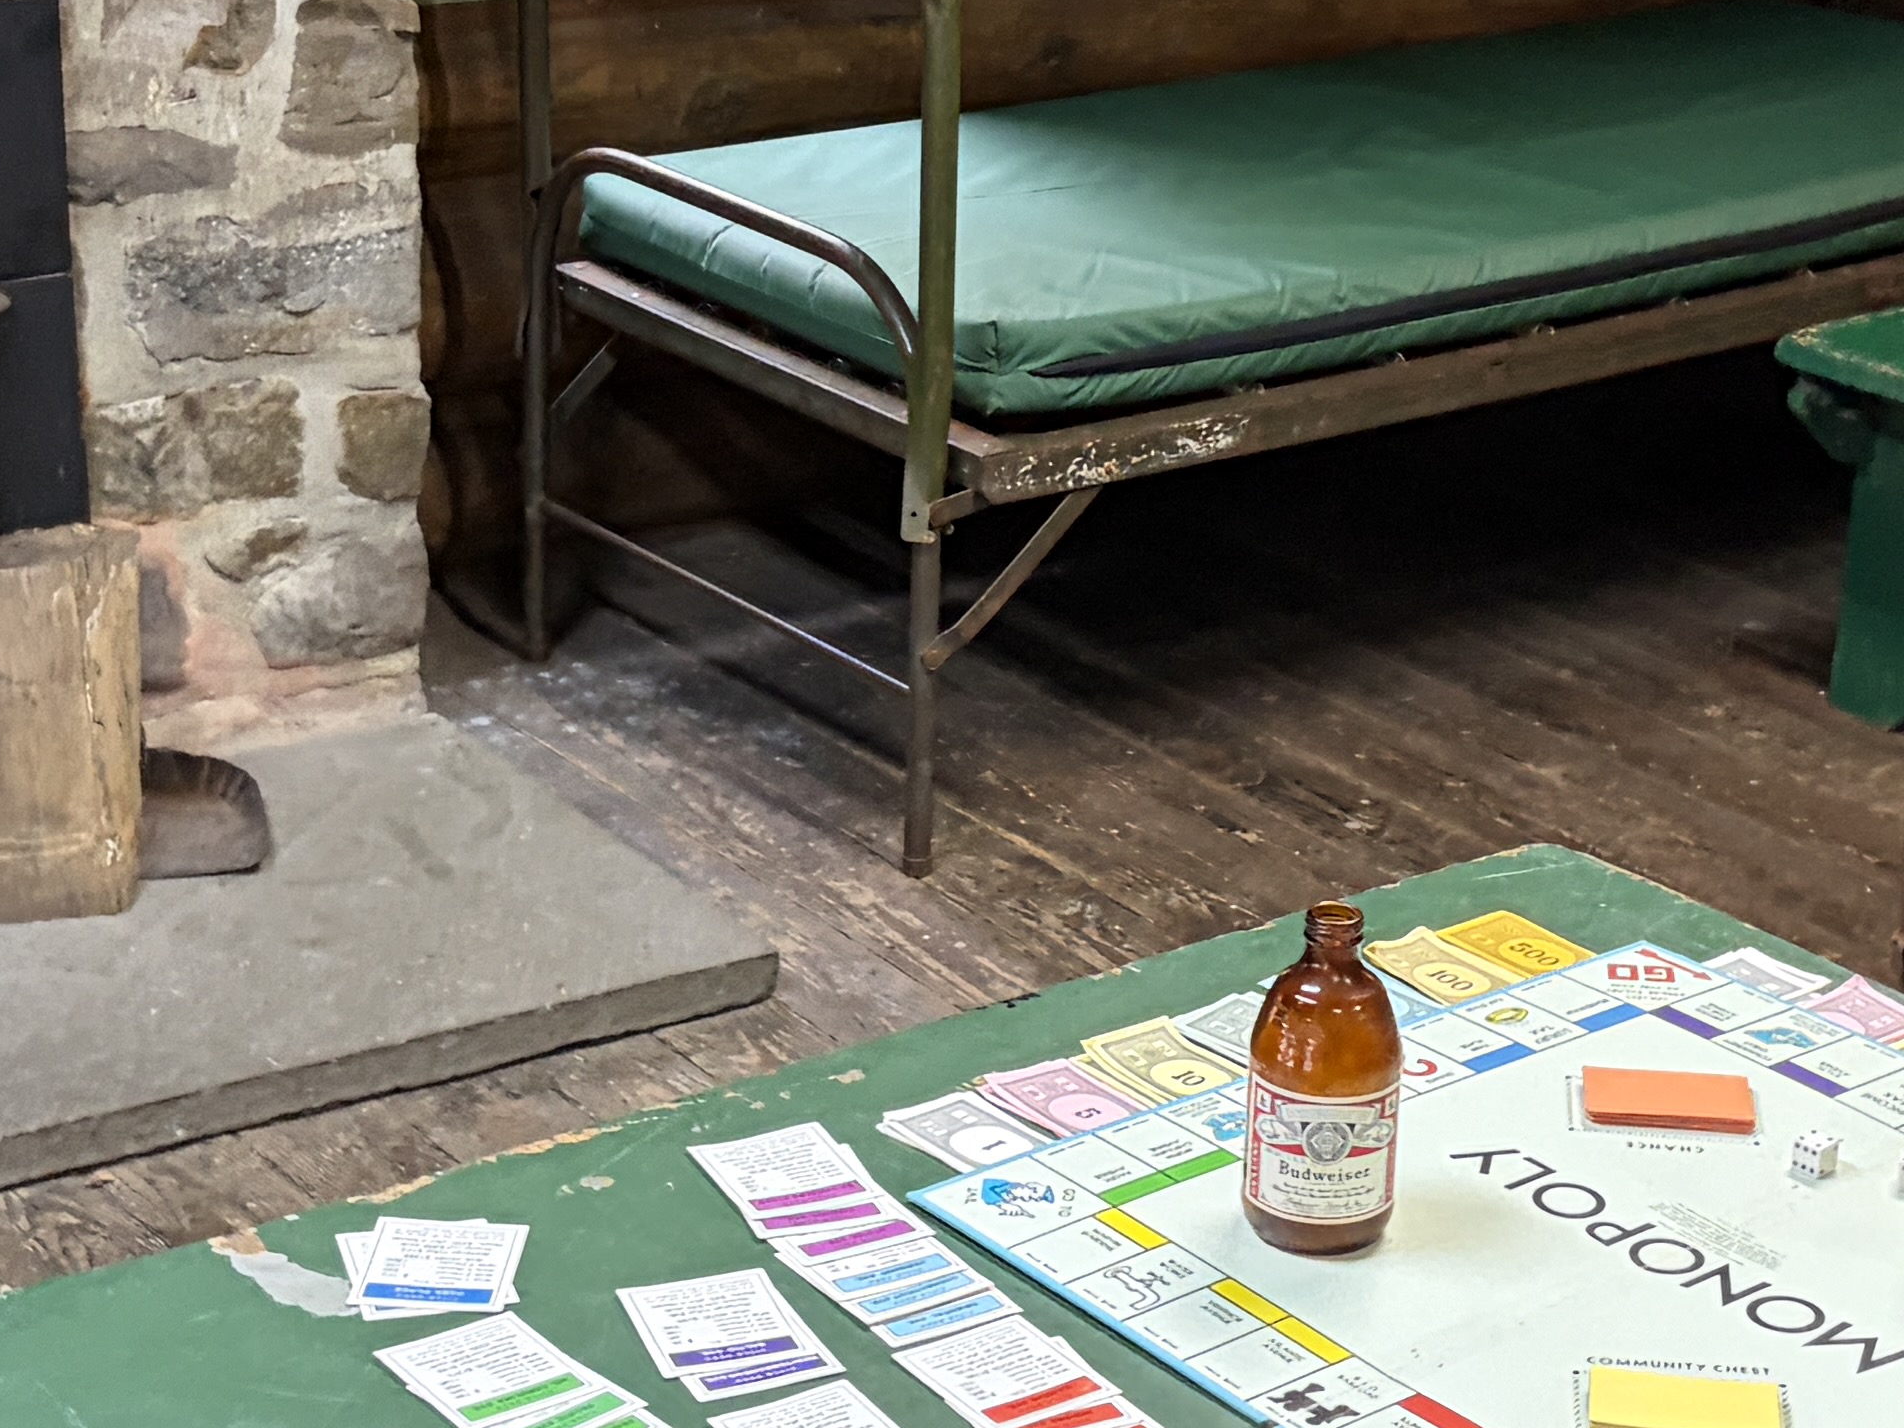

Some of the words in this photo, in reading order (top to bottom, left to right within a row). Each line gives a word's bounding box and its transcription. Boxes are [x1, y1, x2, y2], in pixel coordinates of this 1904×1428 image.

[1507, 942, 1561, 965] 500
[1427, 970, 1475, 992] 100
[1606, 963, 1676, 983] GO
[1171, 1070, 1205, 1087] 10
[1075, 1107, 1101, 1119] 5
[1625, 1141, 1705, 1155] CHANCE
[1279, 1161, 1370, 1181] Budweiser
[1586, 1357, 1705, 1373] COMMUNITY
[1712, 1363, 1771, 1376] CHEST
